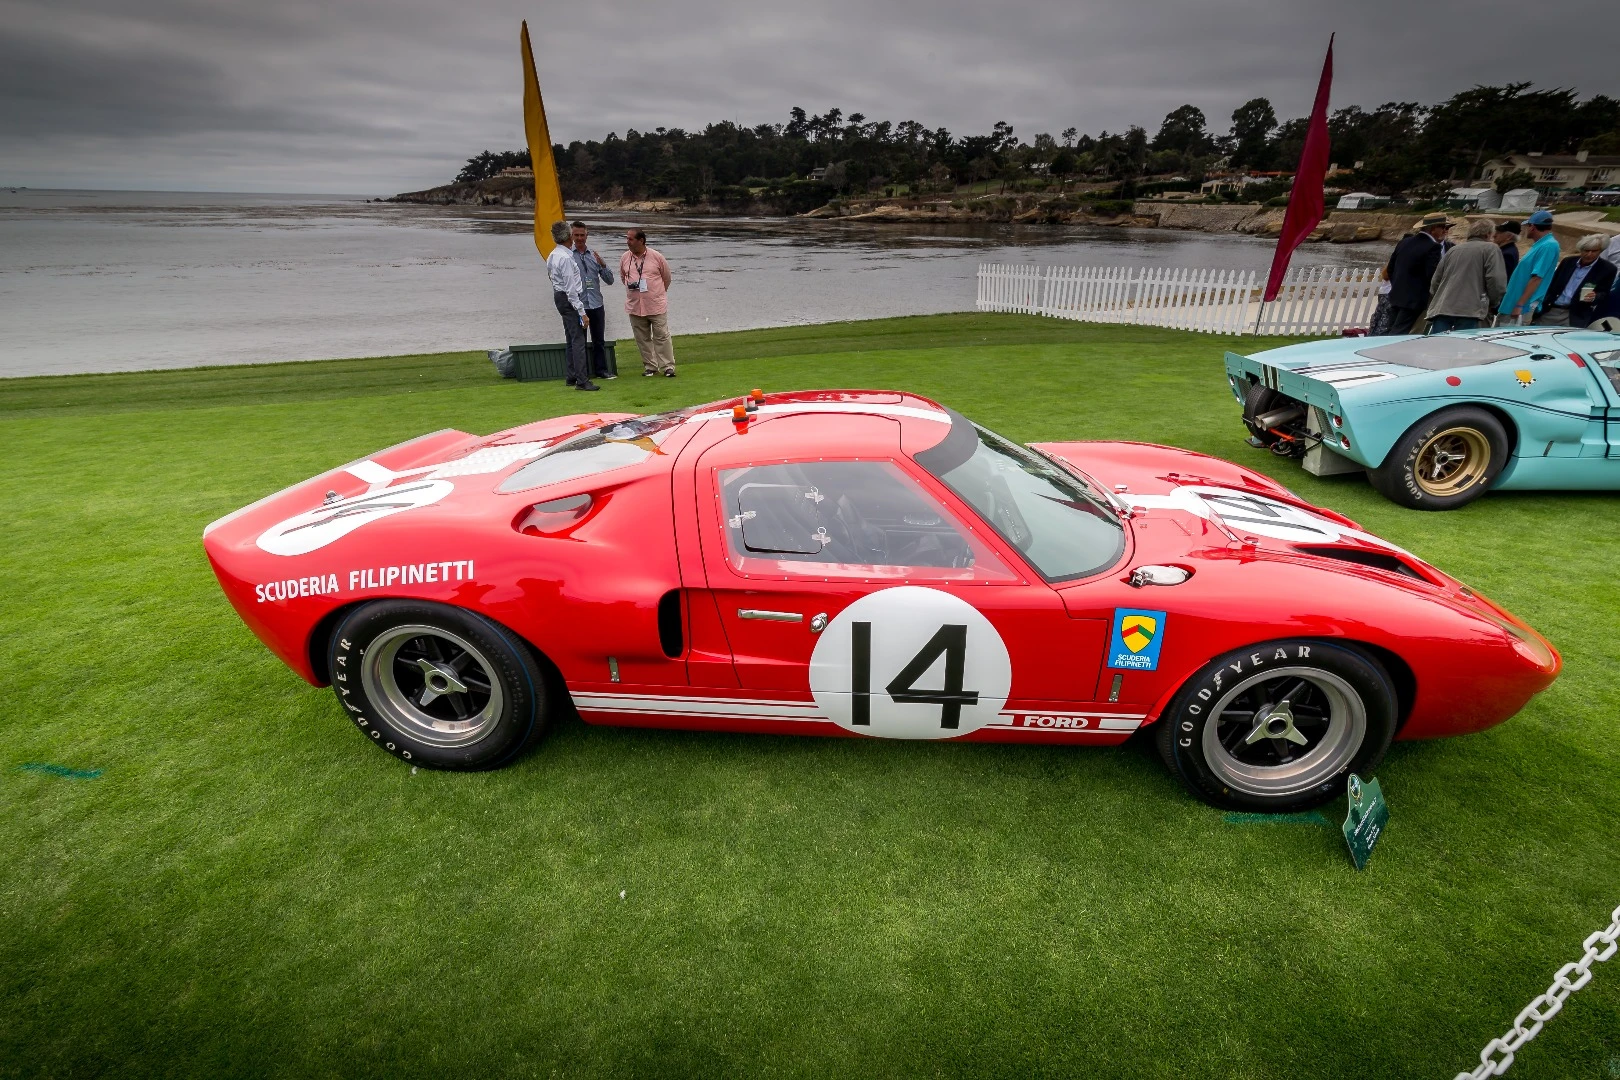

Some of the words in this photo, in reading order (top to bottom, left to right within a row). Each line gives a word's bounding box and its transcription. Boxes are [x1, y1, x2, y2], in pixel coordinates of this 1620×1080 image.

[1403, 426, 1437, 500] GOODYEAR
[255, 573, 339, 603] SCUDERIA
[349, 560, 474, 590] FILIPINETTI
[851, 621, 979, 729] 14
[1114, 660, 1152, 668] FILIPINETTI
[1117, 653, 1151, 663] SCUDERIA
[337, 638, 412, 759] GOODYEAR
[1023, 715, 1089, 729] FORD
[1179, 645, 1311, 747] GOODYEAR
